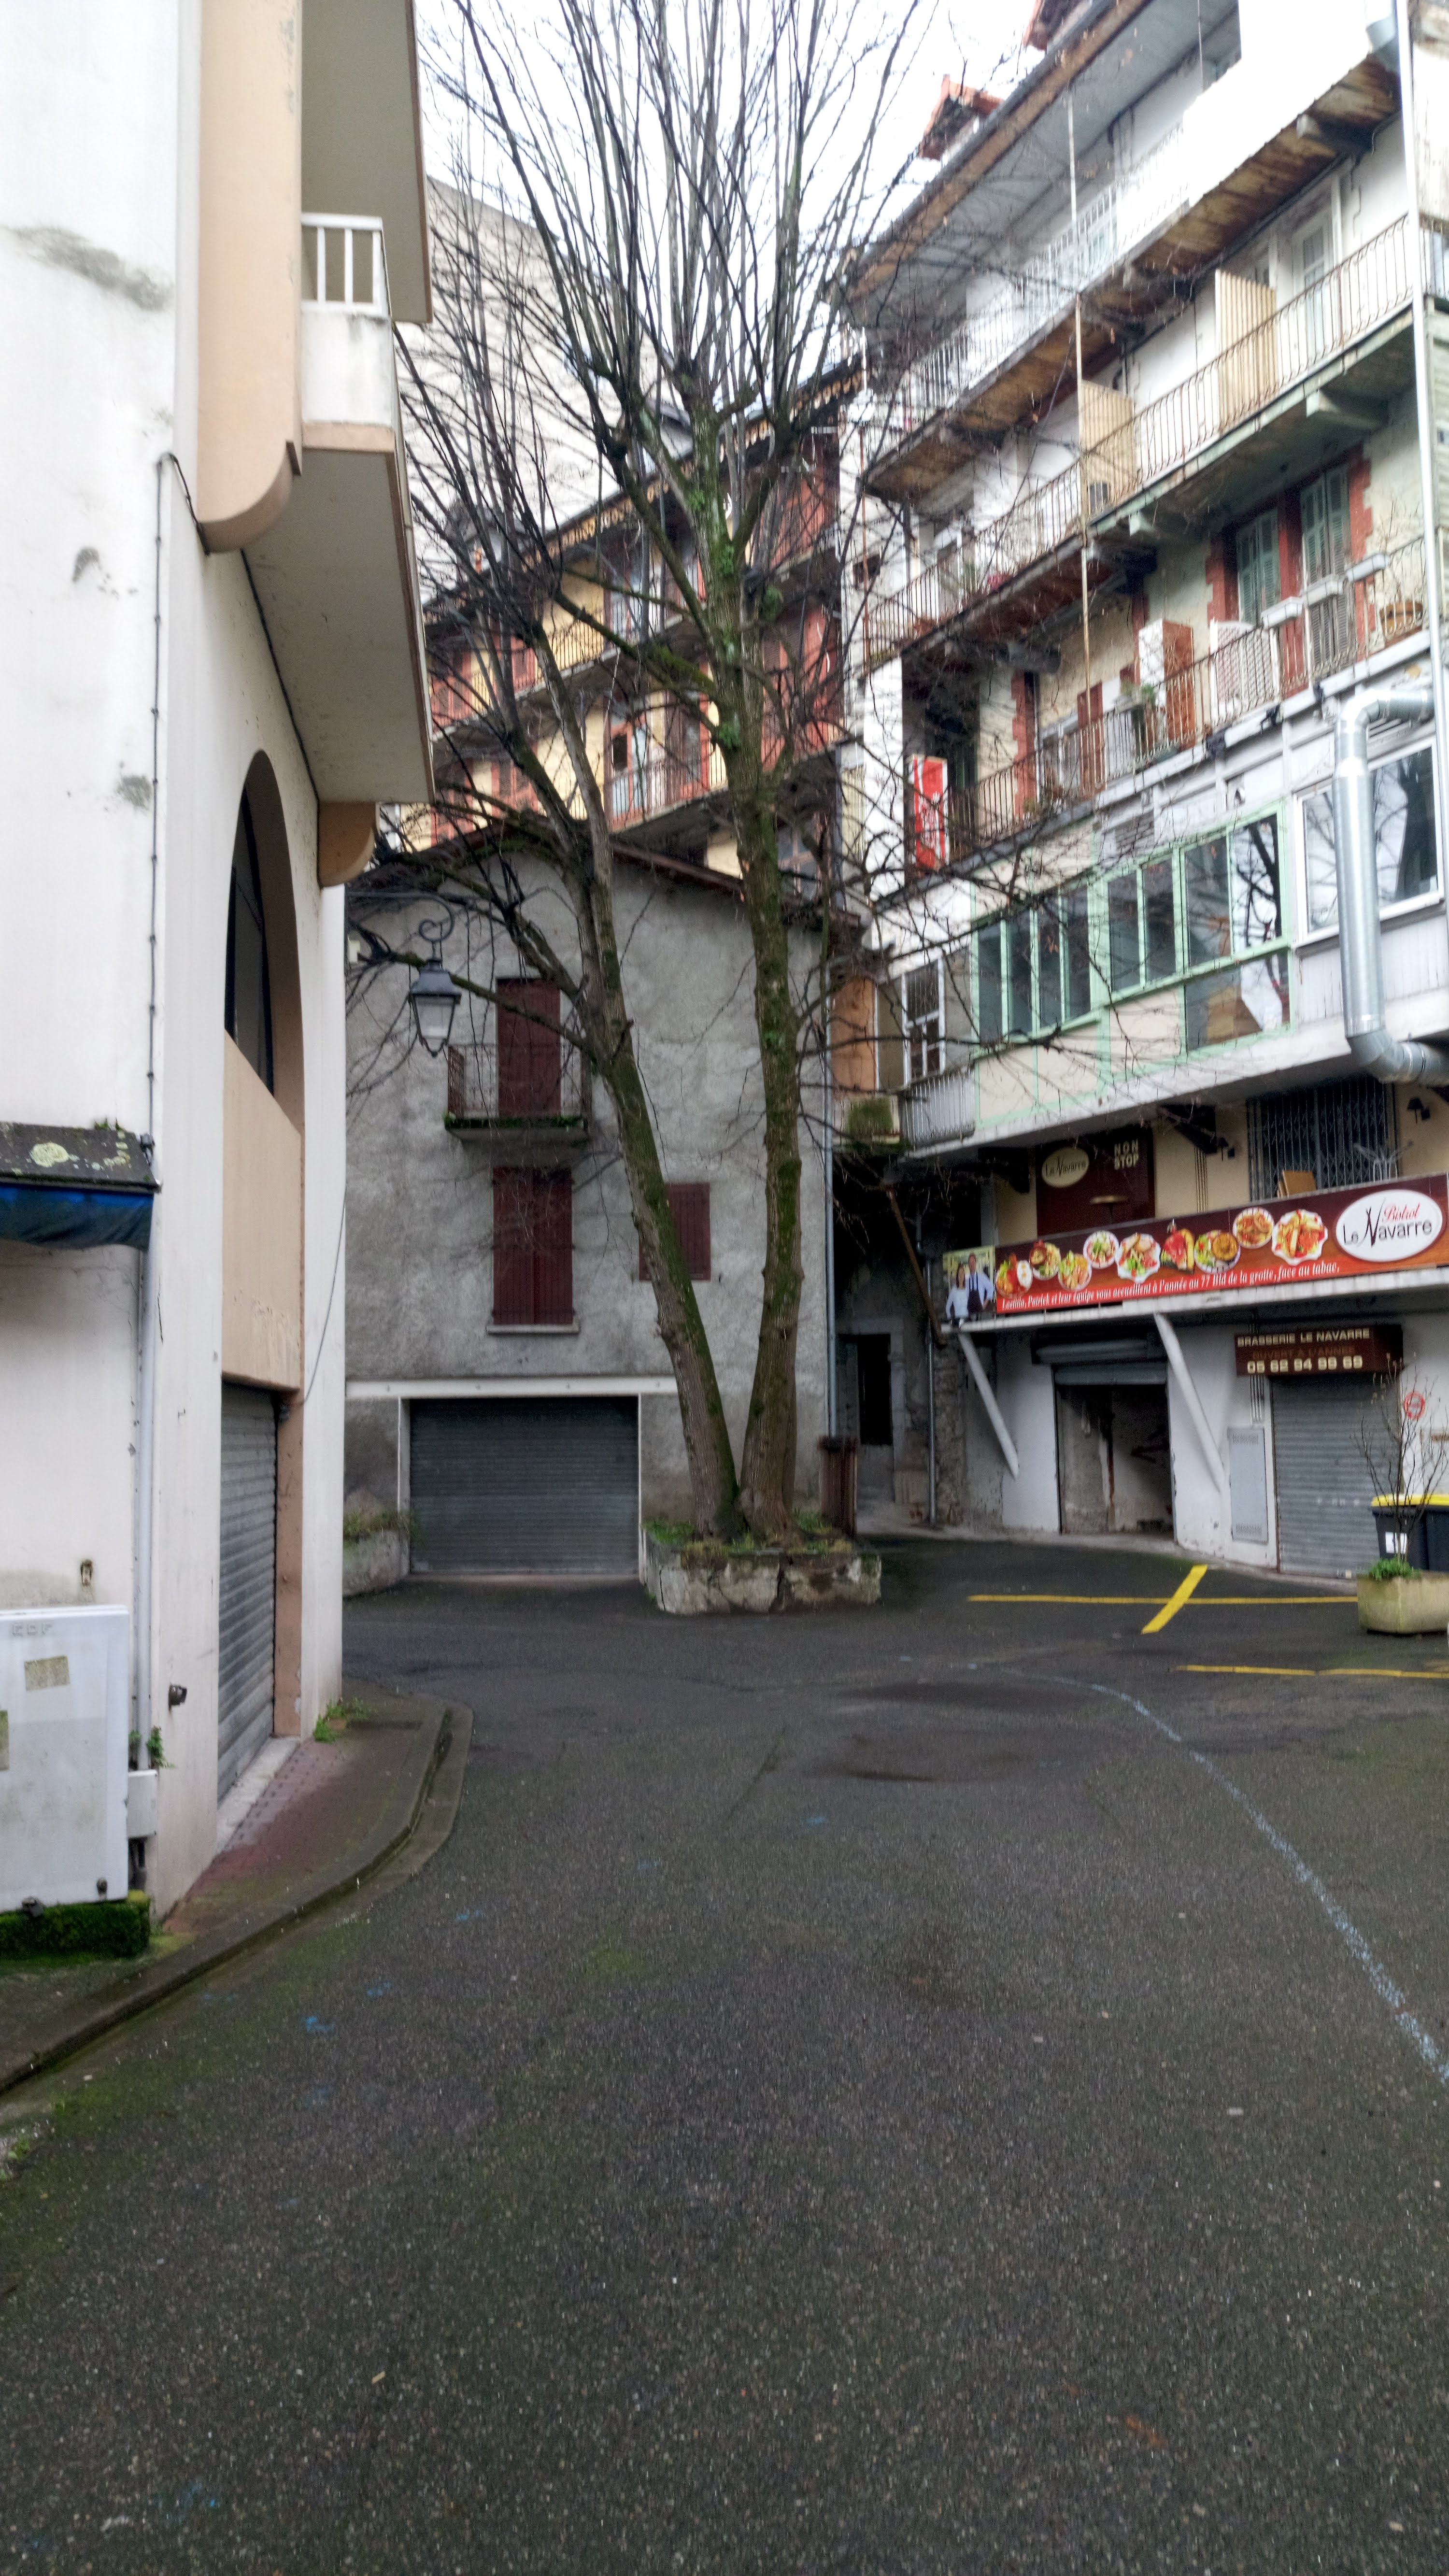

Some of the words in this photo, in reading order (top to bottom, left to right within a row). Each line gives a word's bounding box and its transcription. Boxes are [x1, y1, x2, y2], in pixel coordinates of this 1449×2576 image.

[1114, 1139, 1139, 1156] NON
[1114, 1153, 1139, 1171] STOP
[1382, 1202, 1421, 1223] Bistrot
[1343, 1223, 1359, 1245] Le
[1357, 1197, 1432, 1248] Navarre
[1028, 1292, 1050, 1308] Patrick
[1059, 1291, 1071, 1305] leur
[1096, 1288, 1111, 1300] vous
[1113, 1282, 1151, 1297] accueillent
[1159, 1276, 1187, 1293] l'année
[1189, 1277, 1199, 1289] au
[1201, 1274, 1210, 1288] 77
[1212, 1273, 1226, 1287] Bld
[1228, 1271, 1237, 1284] de
[1240, 1270, 1248, 1283] la
[1277, 1266, 1296, 1282] face
[1298, 1264, 1310, 1277] au
[1312, 1260, 1340, 1275] tabac.
[1237, 1333, 1296, 1347] BRASSERIE
[1300, 1332, 1313, 1343] LE
[1316, 1328, 1370, 1343] NAVARRE
[1247, 1360, 1265, 1374] 05
